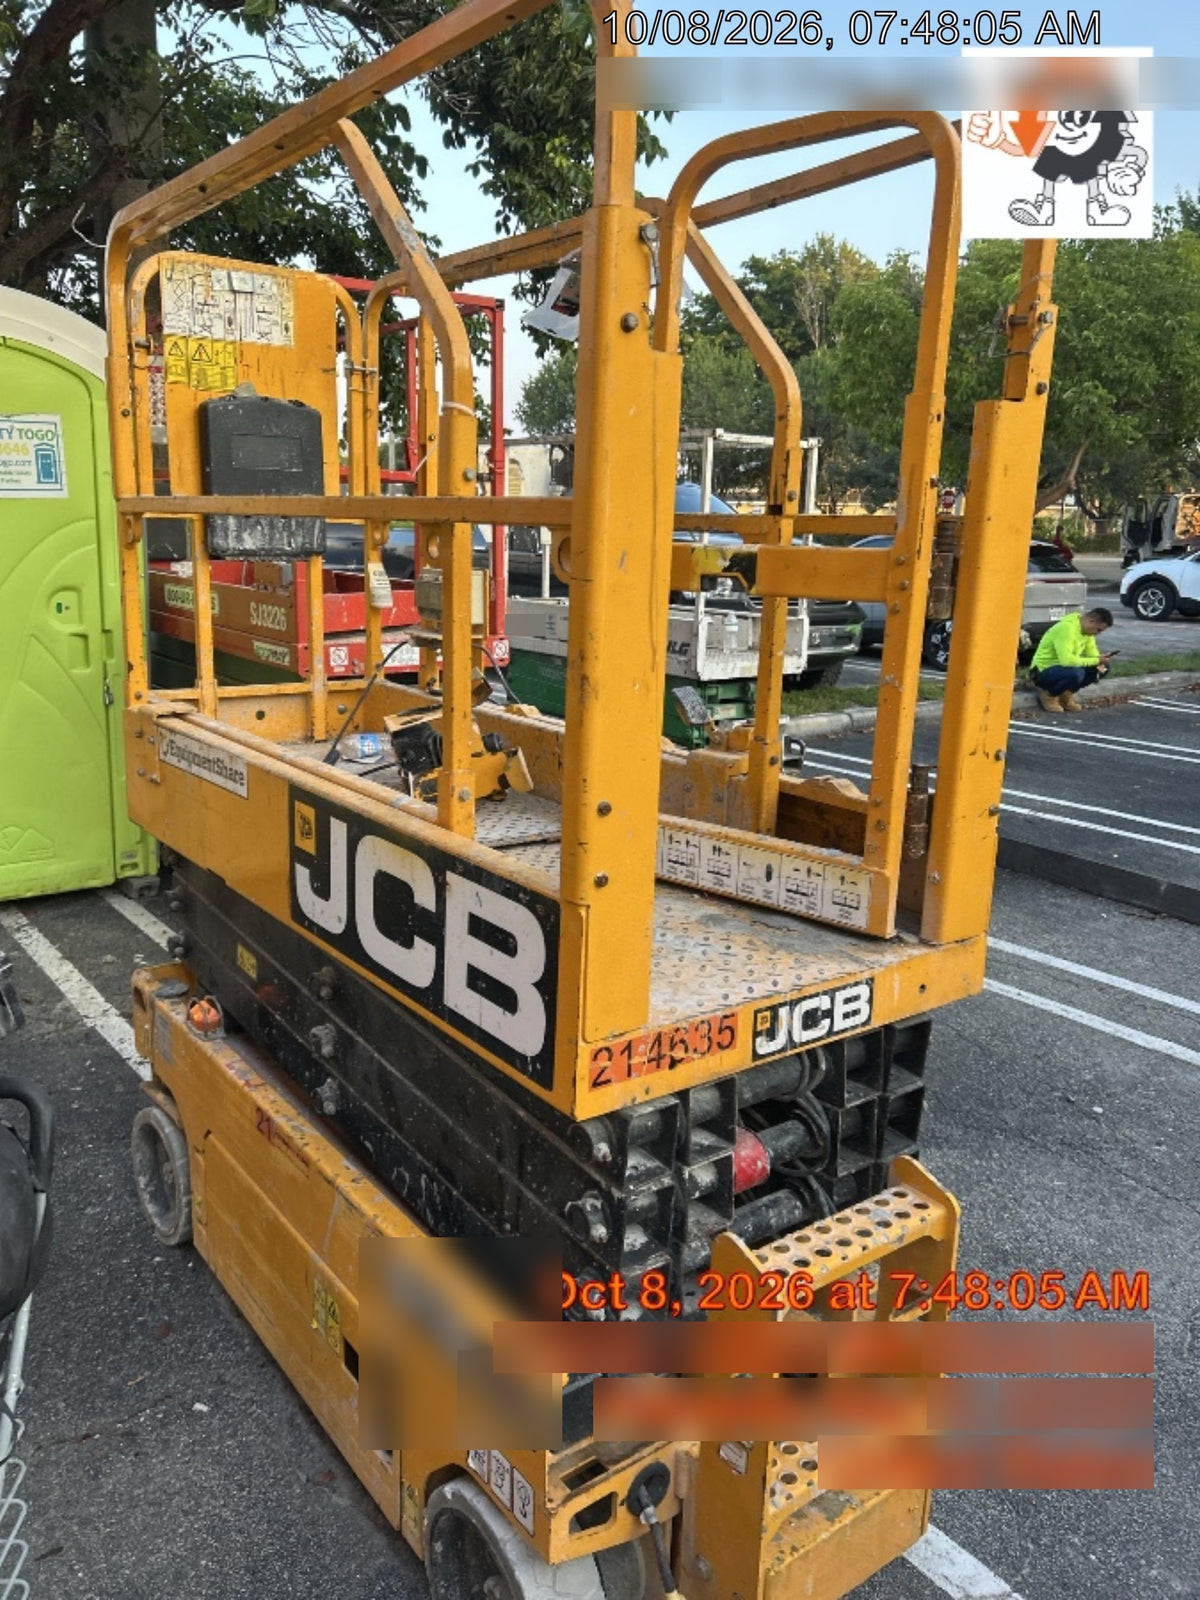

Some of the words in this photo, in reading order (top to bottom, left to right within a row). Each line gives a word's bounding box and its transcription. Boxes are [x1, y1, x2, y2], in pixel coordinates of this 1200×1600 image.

[249, 602, 287, 632] SJ3226
[169, 739, 245, 787] EquipmentShare
[294, 816, 546, 1057] JCB
[754, 983, 871, 1056] JCB
